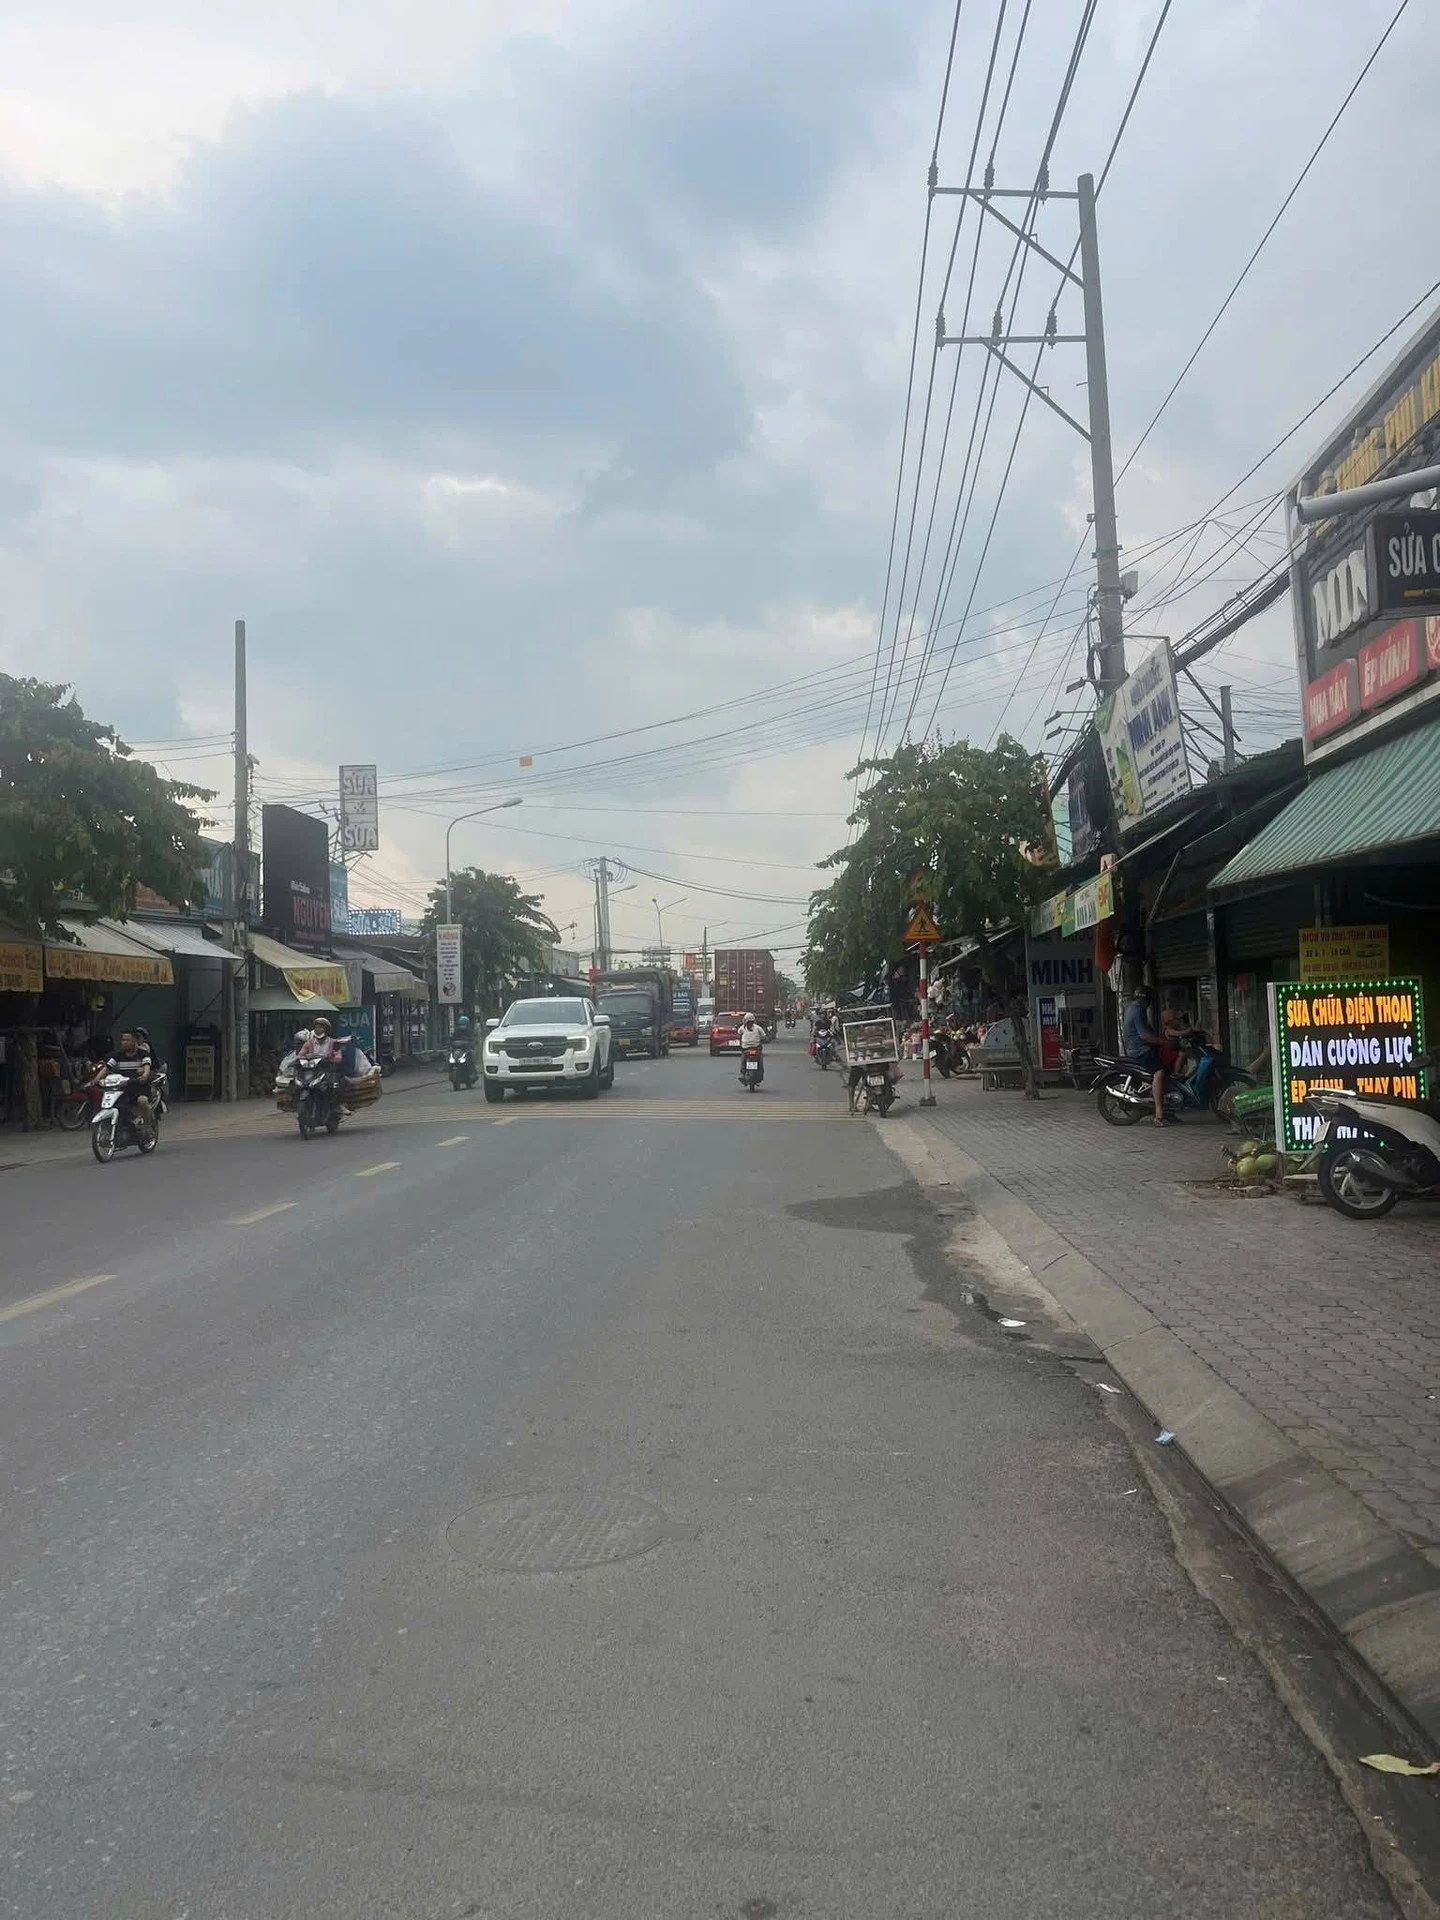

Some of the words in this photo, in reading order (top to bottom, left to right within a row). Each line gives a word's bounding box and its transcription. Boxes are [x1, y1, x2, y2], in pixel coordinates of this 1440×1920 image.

[1388, 521, 1426, 577] SỬA
[1364, 652, 1377, 697] ÉP
[1380, 635, 1410, 687] KÍNH
[1031, 959, 1094, 985] MINH
[1287, 992, 1311, 1028] SỬA
[1312, 993, 1344, 1026] CHỮA
[1346, 991, 1374, 1031] ĐIỆN
[1376, 994, 1413, 1030] THOẠI
[1290, 1035, 1323, 1067] DÁN
[1327, 1032, 1381, 1066] CƯỜNG
[1385, 1036, 1412, 1068] LỰC
[1291, 1075, 1307, 1103] ÉP
[1393, 1076, 1417, 1099] PIN
